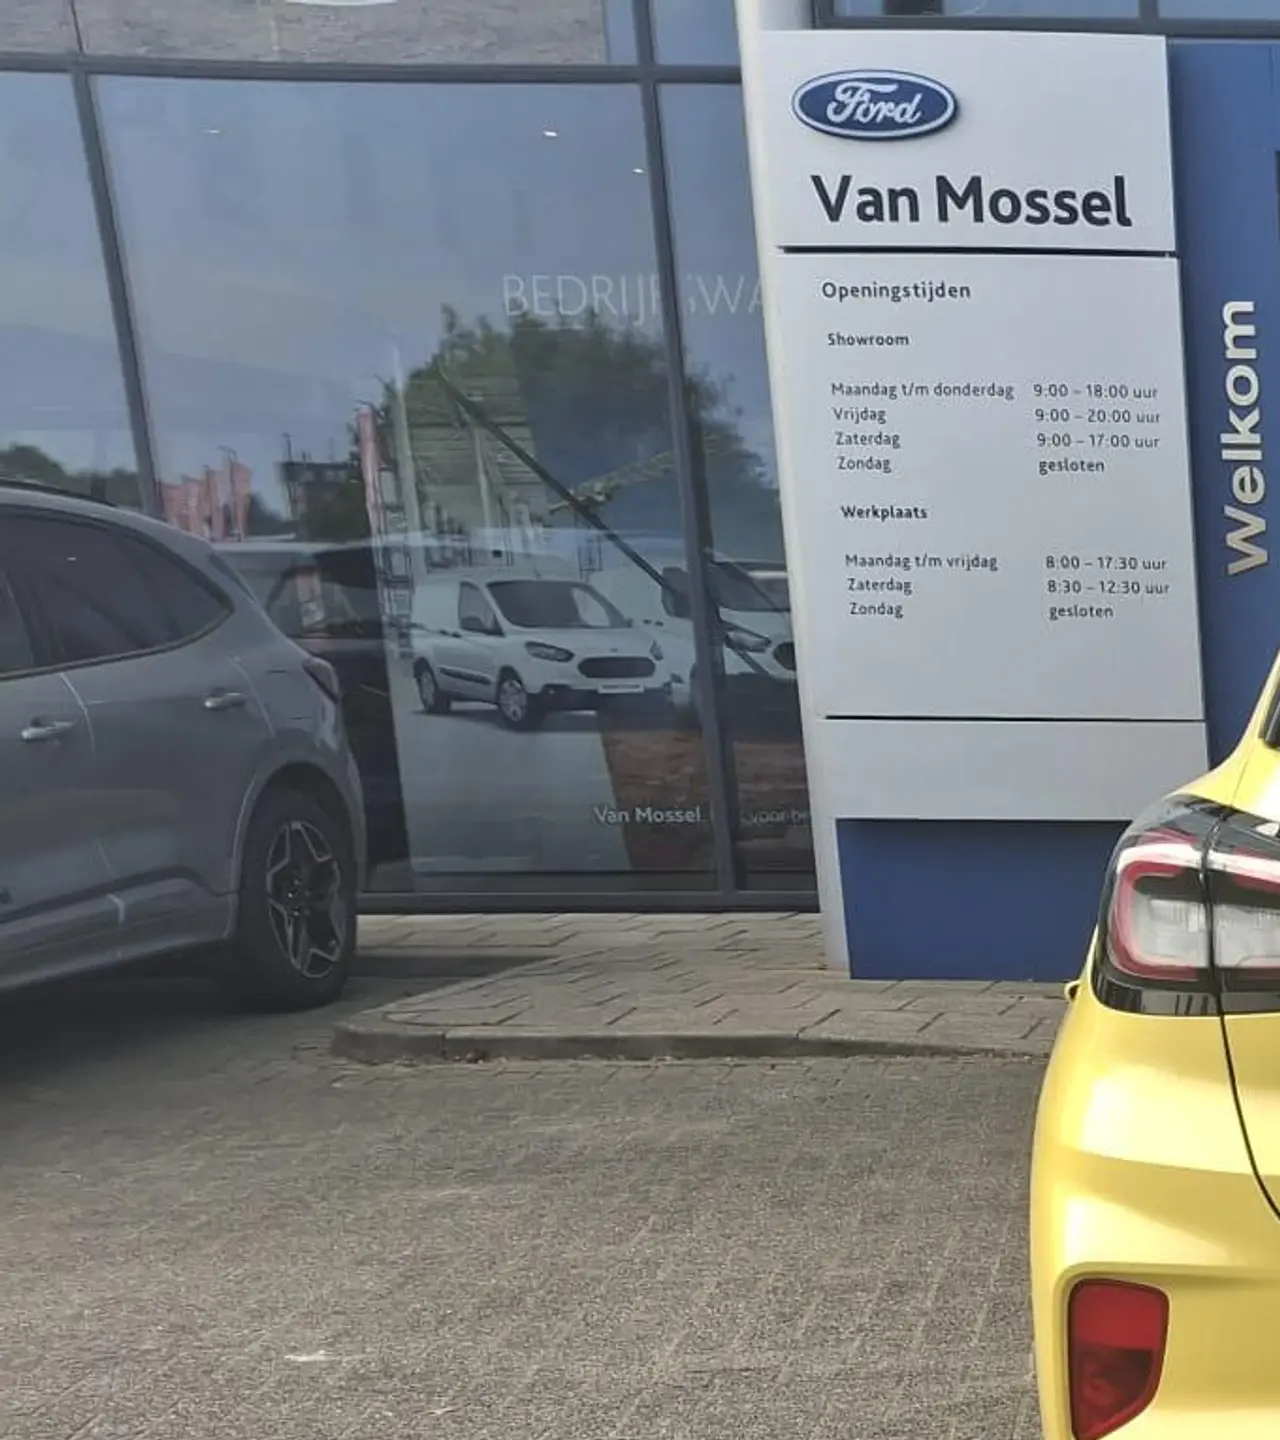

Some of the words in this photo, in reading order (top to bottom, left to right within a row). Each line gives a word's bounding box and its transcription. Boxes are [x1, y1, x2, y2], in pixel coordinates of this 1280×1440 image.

[826, 81, 921, 125] Ford
[811, 175, 919, 222] Van
[936, 175, 1132, 227] Mossel
[822, 281, 970, 302] Openingstijden
[828, 332, 909, 346] Showroom
[831, 382, 897, 400] Maandag
[902, 382, 929, 396] t/m
[934, 382, 1014, 400] donderdag
[1034, 384, 1068, 397] 9:00
[1087, 384, 1128, 398] 18:00
[1133, 388, 1157, 398] uur
[834, 407, 886, 424] Vrijdag
[1034, 409, 1069, 422] 9:00
[1088, 409, 1131, 423] 20:00
[1137, 414, 1159, 423] uur
[836, 432, 900, 449] Zaterdag
[1037, 433, 1071, 447] 9:00
[1089, 434, 1130, 448] 17:00
[1134, 438, 1160, 448] uur
[1221, 299, 1268, 576] Welkom
[838, 456, 892, 473] Zondag
[1039, 458, 1104, 475] gesloten
[841, 505, 927, 522] Werkplaats
[845, 554, 911, 571] Maandag
[915, 554, 942, 567] t/m
[947, 554, 998, 571] vrijdag
[1046, 556, 1079, 569] 8:00
[1097, 556, 1138, 570] 17:30
[1142, 560, 1166, 570] uur
[848, 578, 912, 595] Zaterdag
[1048, 580, 1081, 594] 8:30
[1100, 580, 1140, 594] 12:30
[1145, 584, 1169, 594] uur
[850, 602, 903, 619] Zondag
[1050, 605, 1113, 620] gesloten
[593, 806, 630, 824] Van
[635, 806, 701, 823] Mossel
